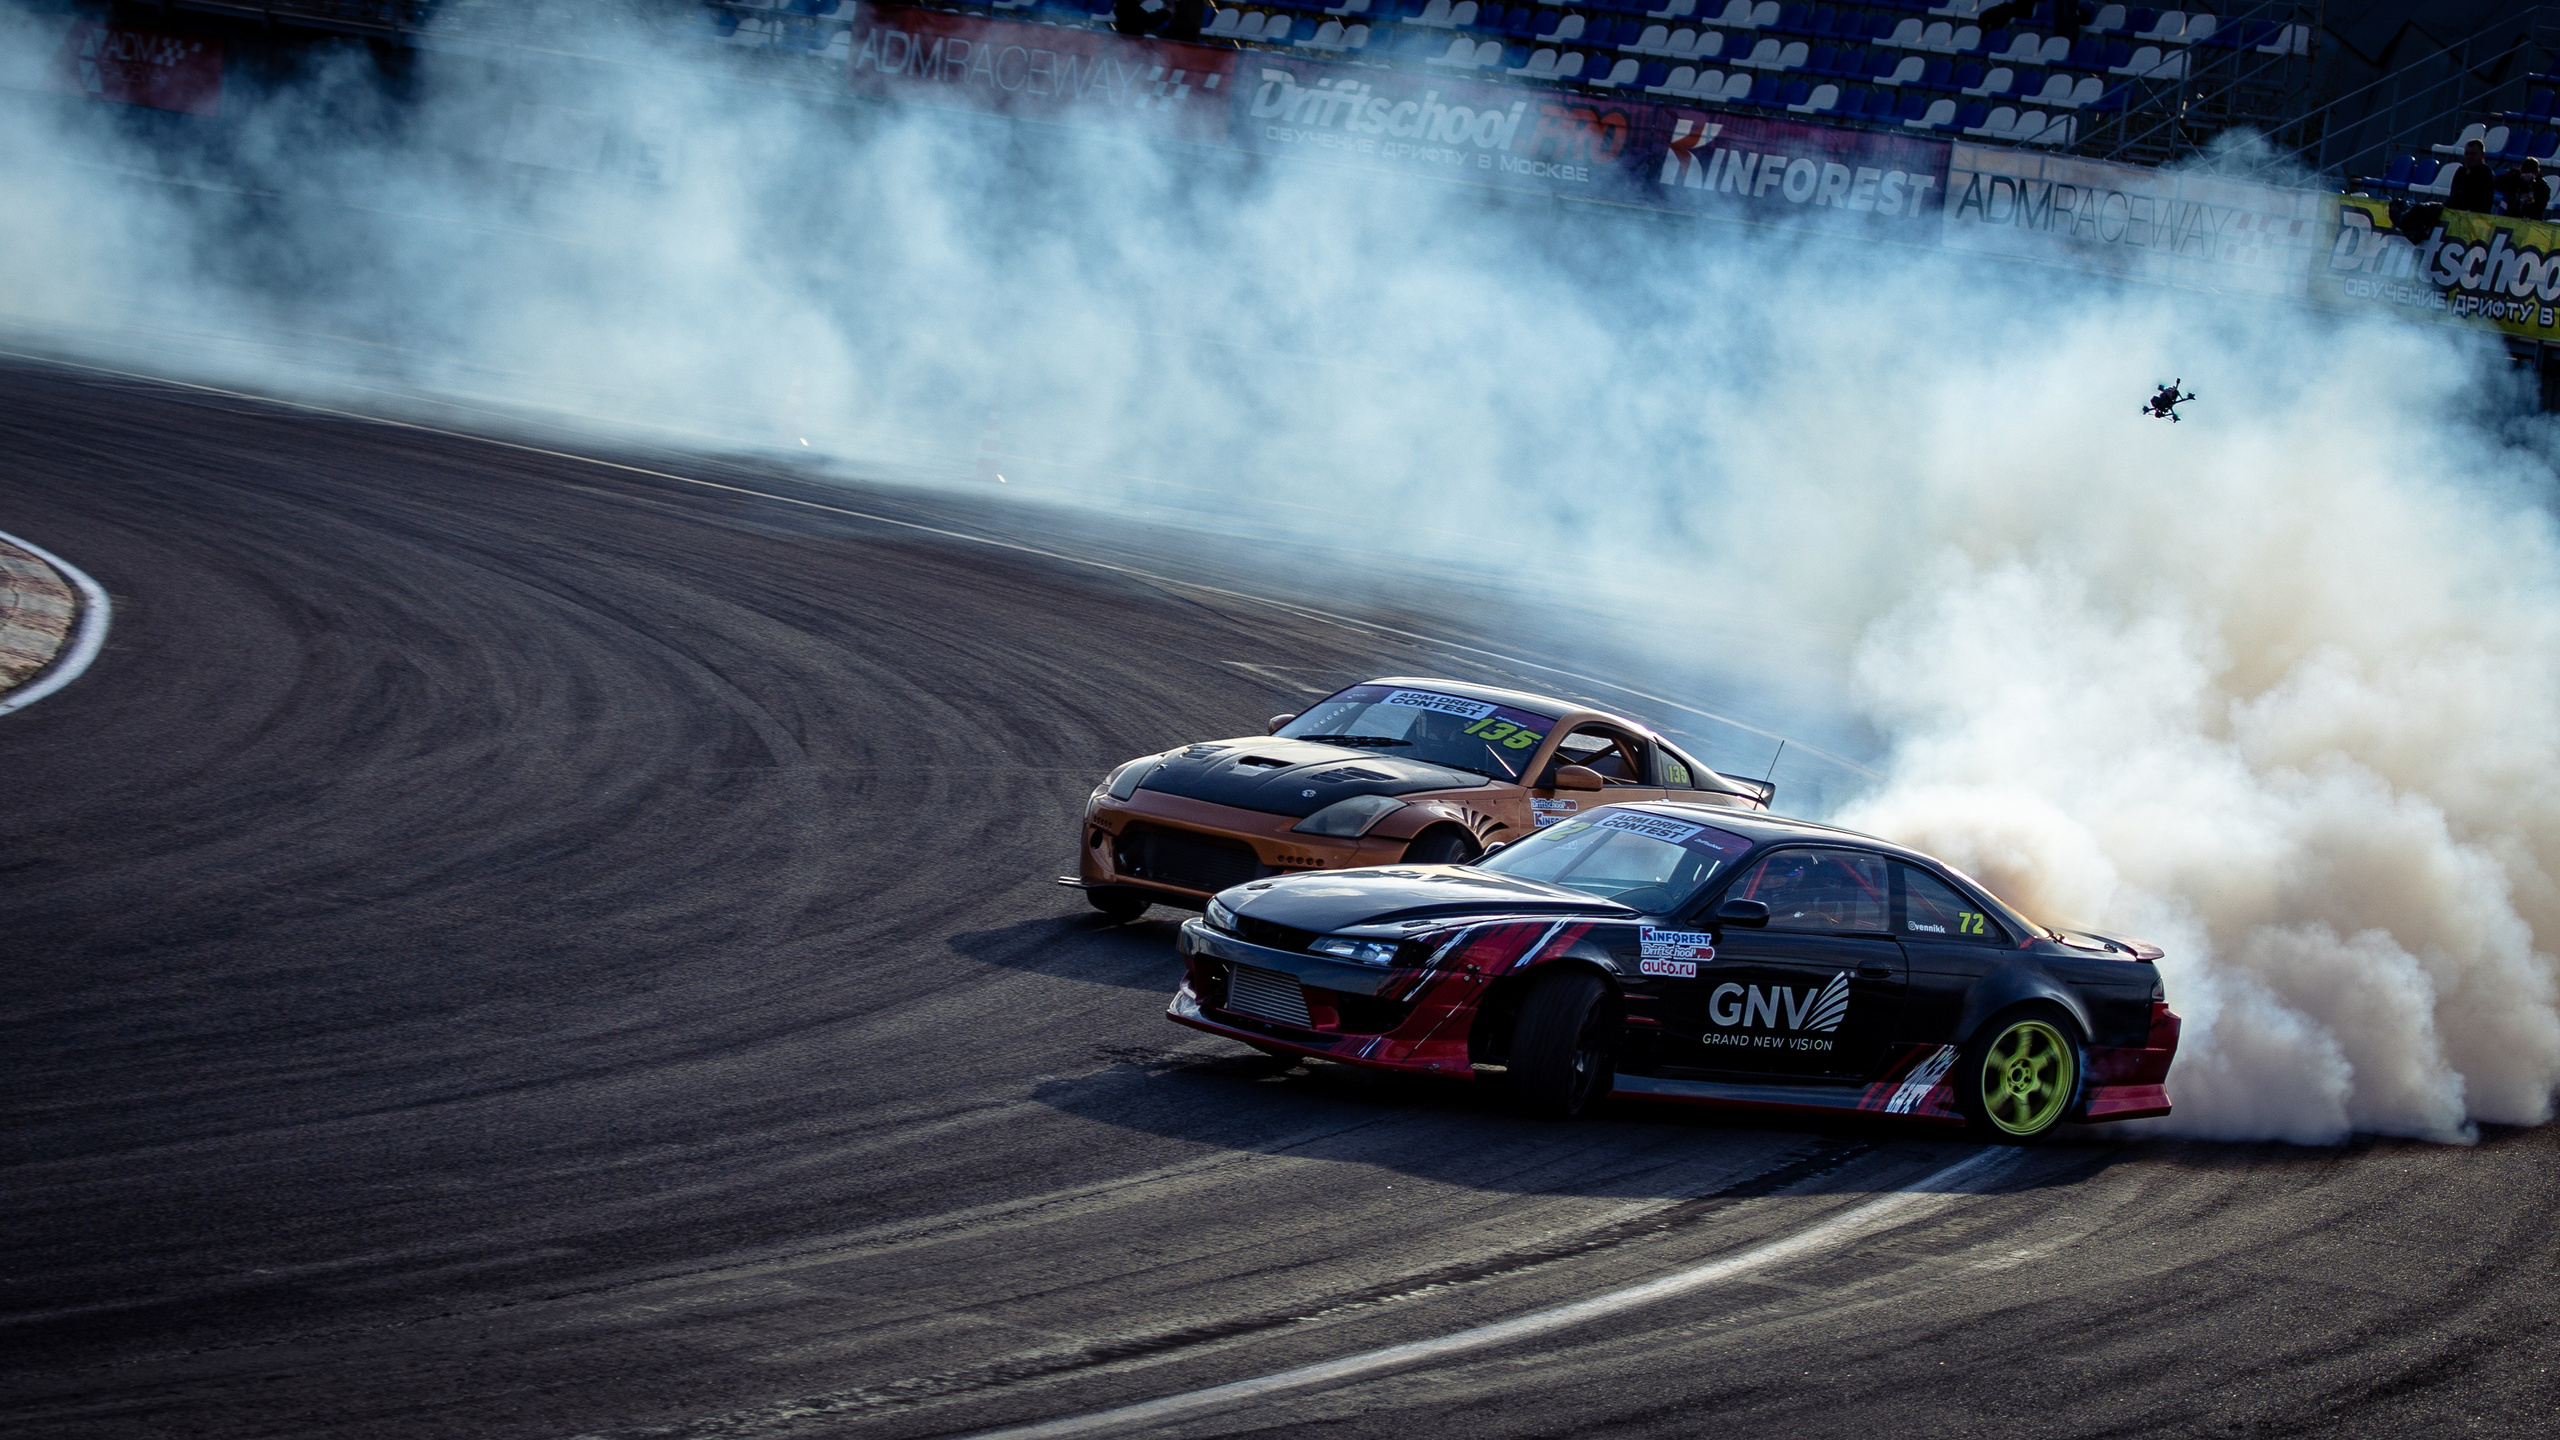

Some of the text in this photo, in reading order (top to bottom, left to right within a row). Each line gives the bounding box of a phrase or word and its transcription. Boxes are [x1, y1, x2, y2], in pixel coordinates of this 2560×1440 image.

[1266, 125, 1374, 154] ОБУЧЕНИЕ
[1382, 140, 1469, 167] ДРИФТУ
[1477, 153, 1493, 170] В
[1660, 118, 1936, 219] KINFOREST
[1955, 172, 2233, 259] ADMRACEWAY
[2344, 278, 2554, 326] ОБУЧЕНИЕ ДРИФТУ В
[1389, 697, 1484, 717] CONTEST
[1400, 692, 1490, 710] ADM DRIFT
[1461, 717, 1544, 750] 135
[1667, 764, 1688, 784] 135
[1602, 820, 1686, 840] CONTEST
[1613, 814, 1696, 833] ADM DRIFT
[1908, 920, 1946, 934] @vennikk
[1958, 911, 1984, 935] 72
[1641, 927, 1710, 945] KINFOREST
[1642, 960, 1694, 976] auto.ru
[1708, 982, 1819, 1031] GNV
[1702, 1033, 1833, 1051] GRAND NEW VISION
